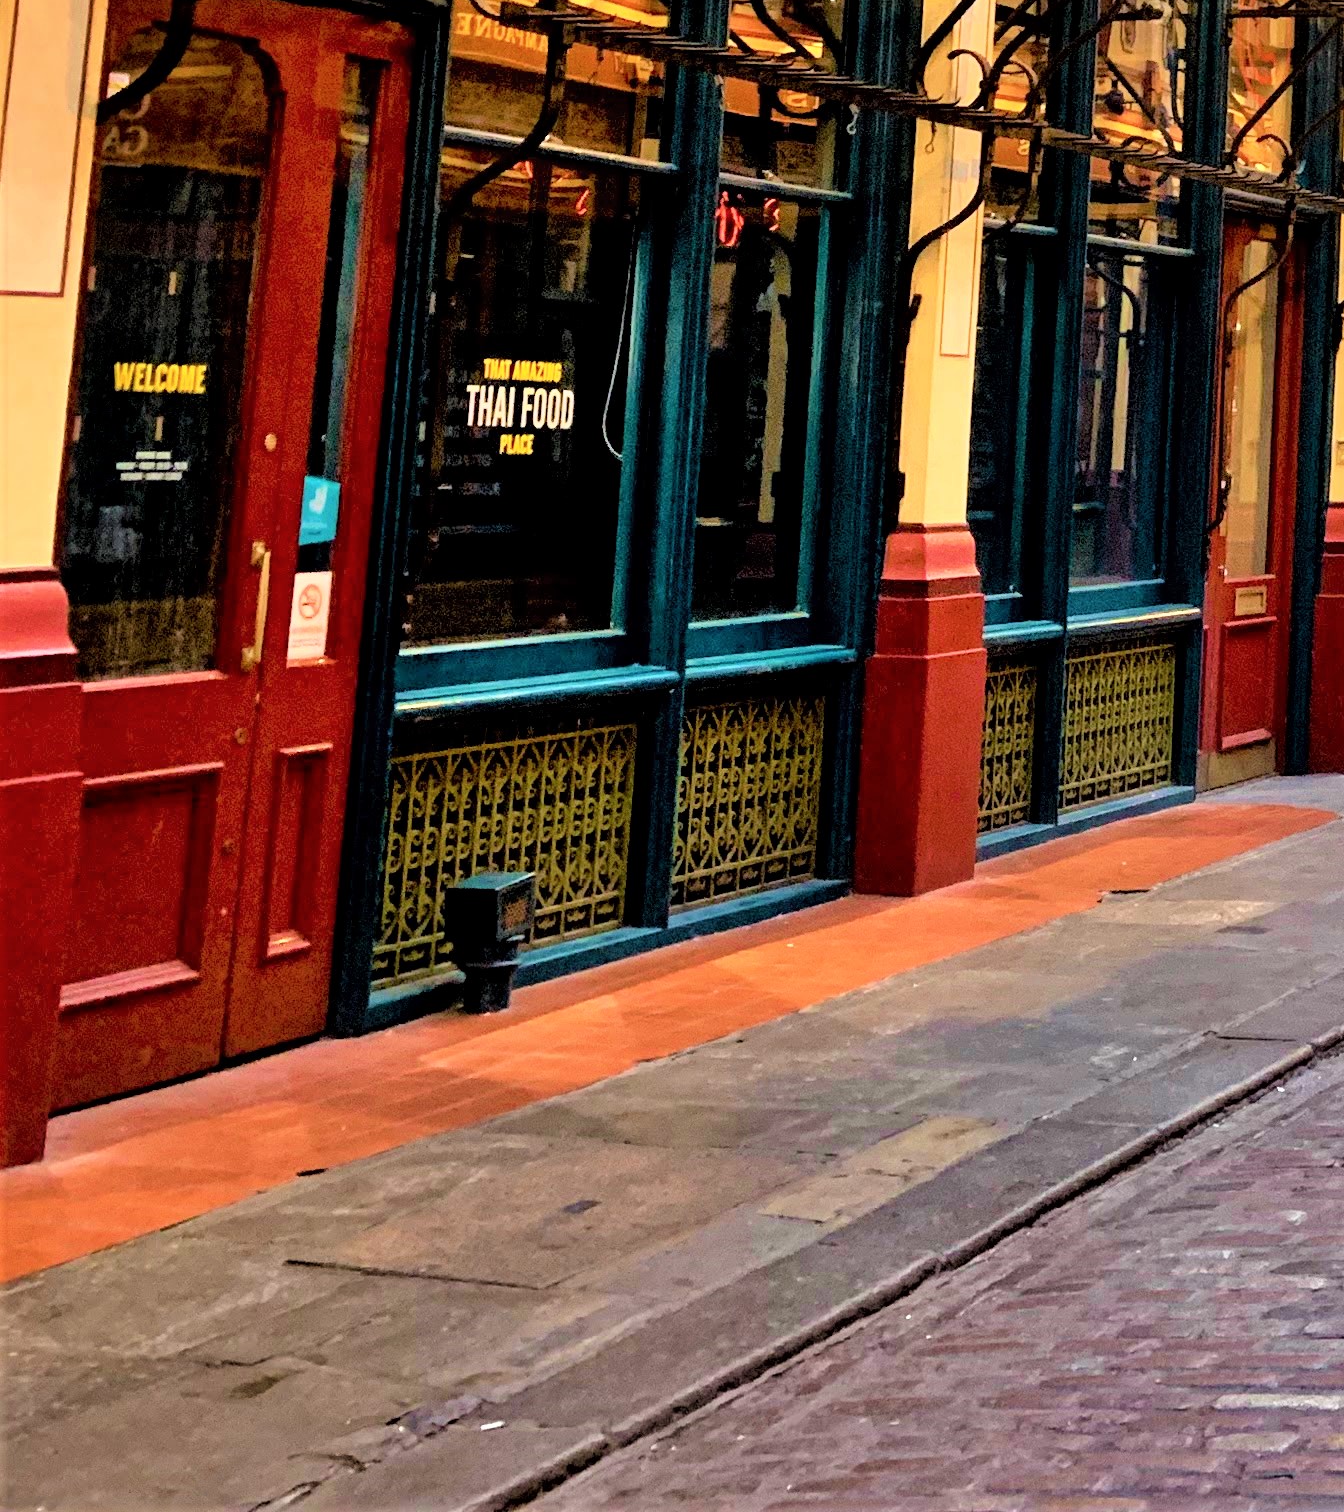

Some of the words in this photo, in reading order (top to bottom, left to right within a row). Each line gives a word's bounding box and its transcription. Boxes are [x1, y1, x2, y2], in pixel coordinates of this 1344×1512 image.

[113, 361, 208, 395] WELCOME
[483, 358, 513, 381] THAT
[511, 360, 563, 384] AMAZING
[466, 384, 516, 428] THAI
[520, 387, 575, 430] FOOD
[499, 434, 535, 455] PLACE
